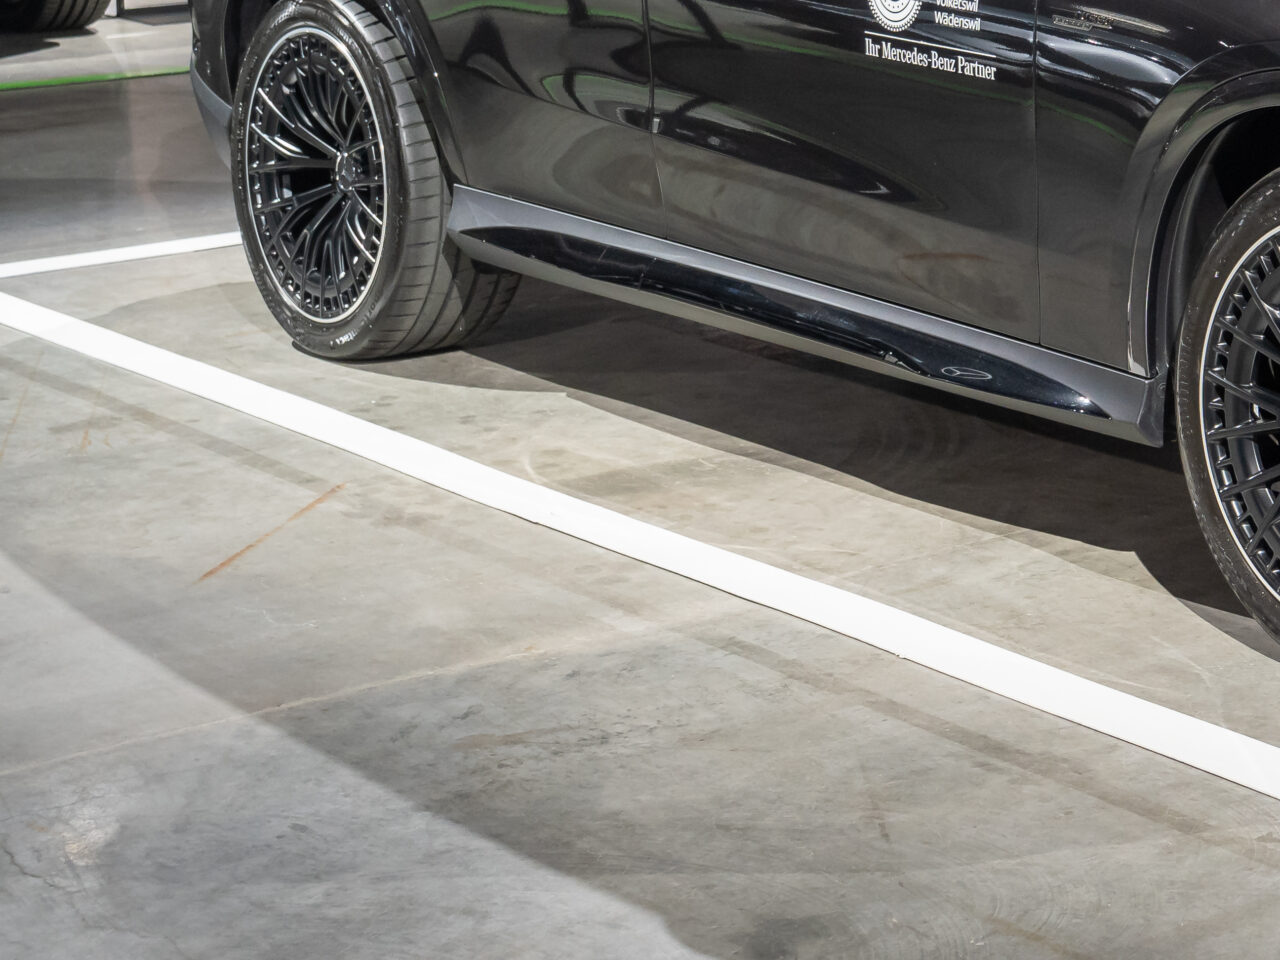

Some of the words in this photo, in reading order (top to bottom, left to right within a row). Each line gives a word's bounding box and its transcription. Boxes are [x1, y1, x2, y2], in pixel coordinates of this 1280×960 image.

[934, 11, 981, 31] Wädenswil
[864, 37, 880, 58] Ihr
[881, 41, 956, 73] Mercedes-Benz
[957, 55, 997, 80] Partner
